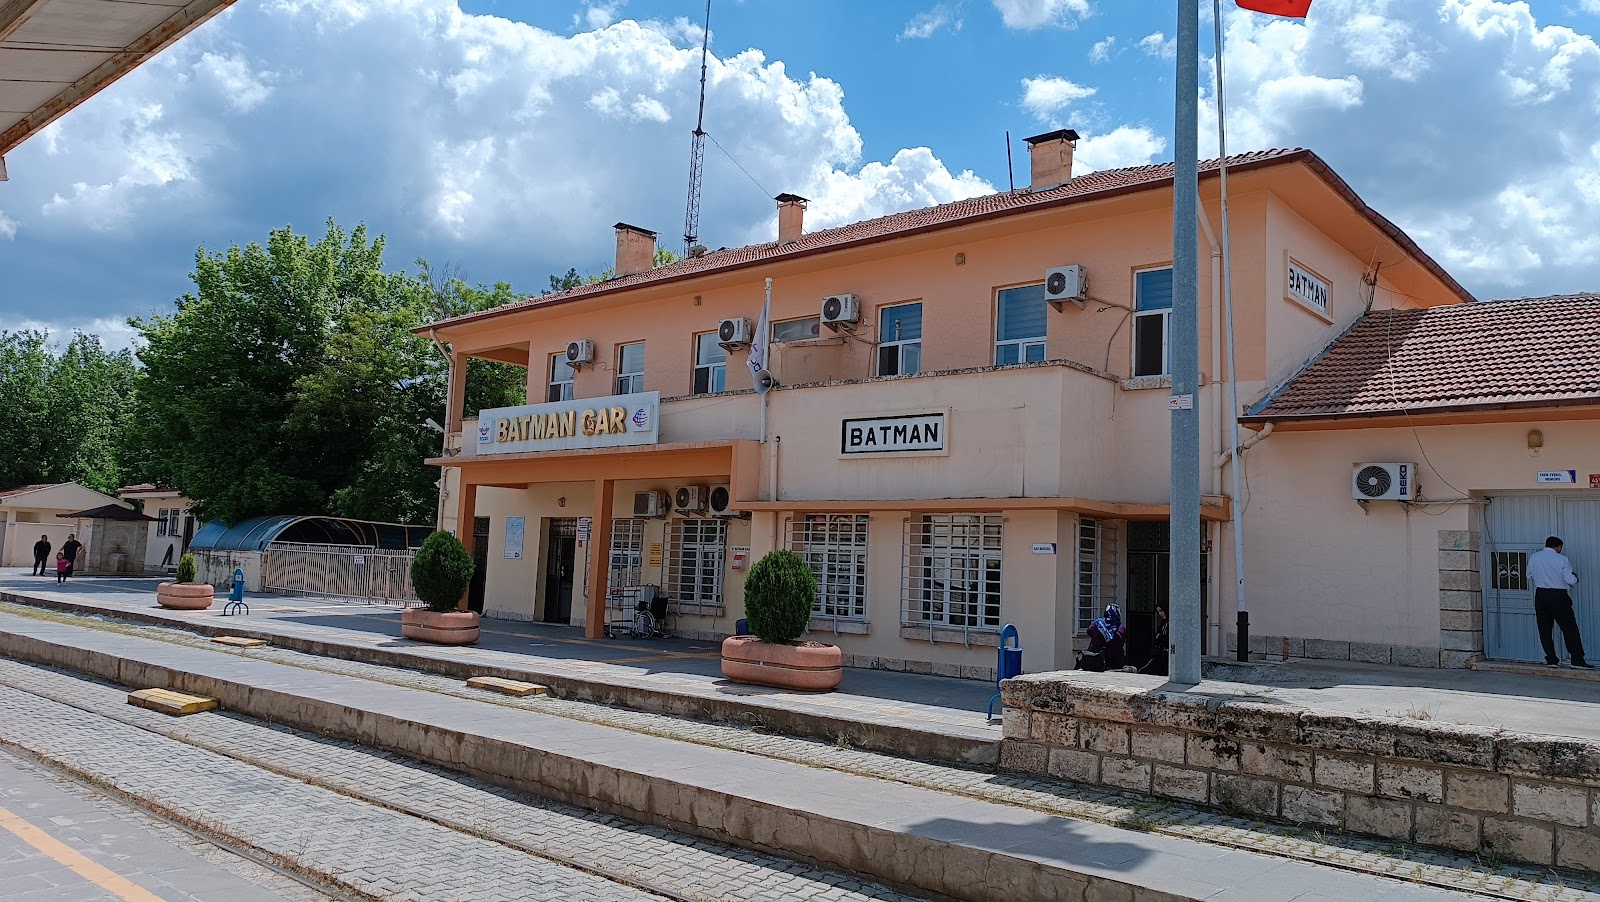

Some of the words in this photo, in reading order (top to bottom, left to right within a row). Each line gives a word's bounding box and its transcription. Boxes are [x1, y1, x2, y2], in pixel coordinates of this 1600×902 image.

[1289, 267, 1327, 308] BATMAN
[496, 410, 577, 443] BATMAN
[581, 406, 627, 436] GAR
[850, 422, 939, 447] BATMAN
[1399, 464, 1408, 496] BEKO
